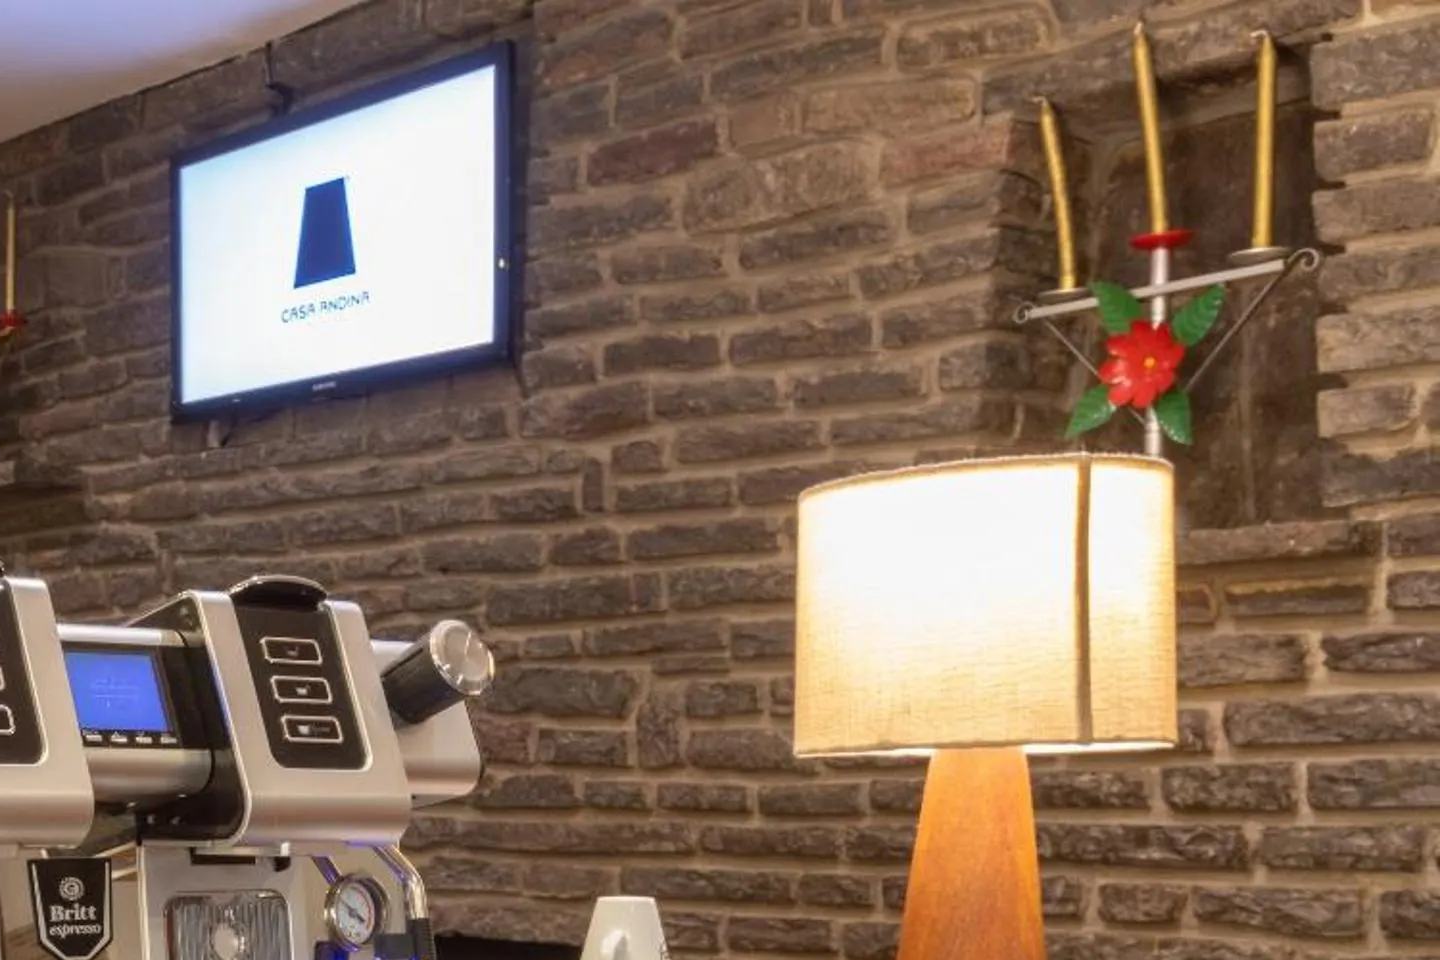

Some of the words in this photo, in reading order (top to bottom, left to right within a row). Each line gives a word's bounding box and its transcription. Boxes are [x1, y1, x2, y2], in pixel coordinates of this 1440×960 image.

[281, 303, 316, 323] CASA
[320, 291, 370, 312] ANDINA
[49, 902, 97, 922] Britt
[49, 923, 102, 938] espresso
